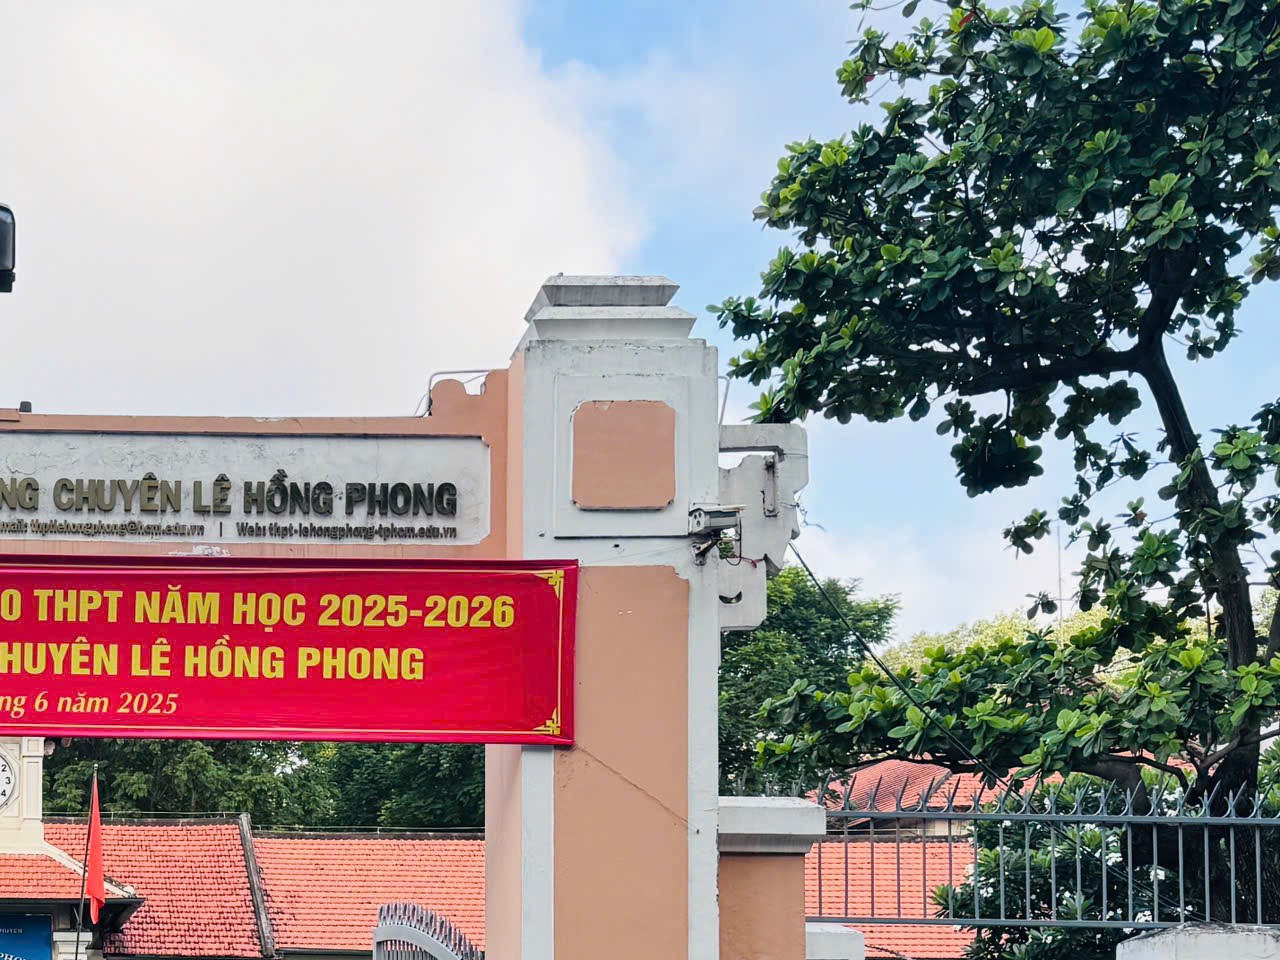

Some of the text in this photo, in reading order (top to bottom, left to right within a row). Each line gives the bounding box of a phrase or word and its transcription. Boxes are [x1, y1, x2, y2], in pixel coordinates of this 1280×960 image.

[53, 471, 181, 513] CHUYÊN
[193, 473, 231, 514] LÊ
[244, 468, 333, 515] HỒNG
[345, 482, 457, 516] PHONG
[34, 589, 122, 623] THPT
[134, 584, 220, 624] NĂM
[232, 592, 306, 632] HỌC
[318, 593, 515, 628] 2025-2026
[131, 637, 171, 678] LÊ
[185, 634, 285, 679] HỒNG
[298, 646, 424, 681] PHONG
[34, 692, 50, 714] 6
[57, 691, 110, 715] năm
[117, 693, 178, 715] 2025
[1, 764, 7, 772] 2
[1, 789, 6, 797] 4
